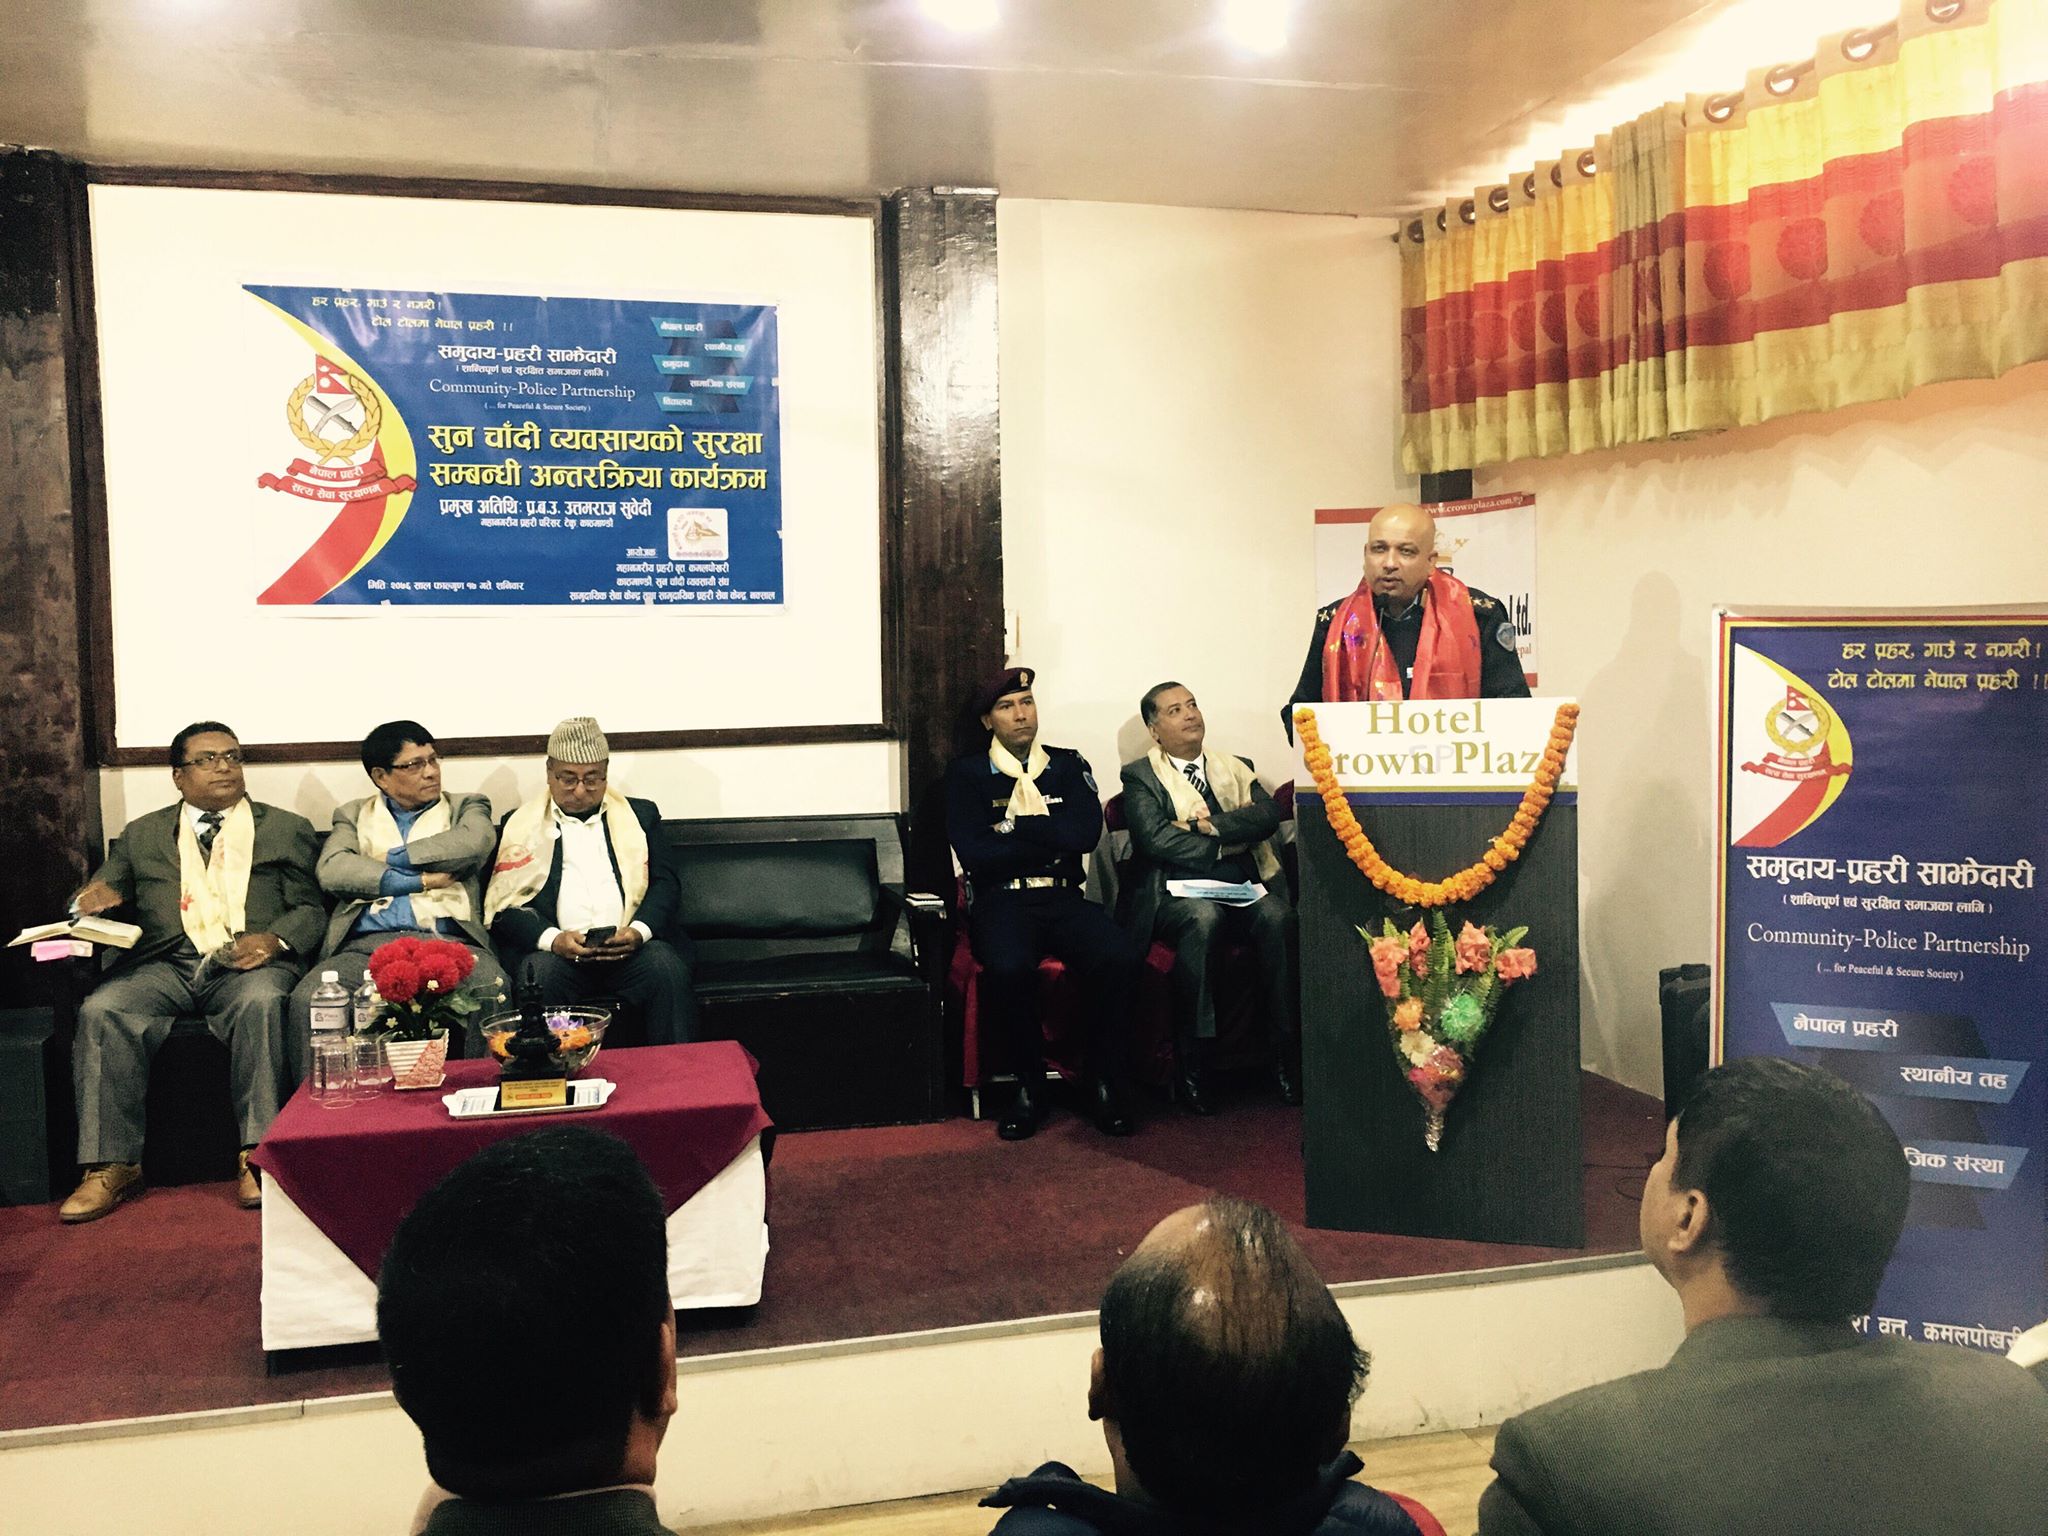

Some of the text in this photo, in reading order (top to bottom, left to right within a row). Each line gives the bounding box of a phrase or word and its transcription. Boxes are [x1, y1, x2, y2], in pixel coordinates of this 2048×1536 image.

[438, 344, 617, 365] समुदाय-प्रहरी साझेदारी
[429, 378, 636, 402] Community-Police Partnership
[427, 420, 763, 460] सुन चाँदी व्यवसायको सुरक्षा
[429, 458, 767, 491] सम्बन्धी अन्तरक्रिया कार्यक्रम
[439, 498, 473, 517] प्रमुख
[564, 500, 616, 516] उत्तमराज
[620, 497, 652, 519] सुवेदी
[1841, 642, 1866, 660] हर
[1964, 642, 1977, 659] र
[1827, 668, 1858, 689] टोल
[1866, 668, 1916, 689] टोलमा
[1923, 668, 1969, 689] नेपाल
[1976, 668, 2020, 692] प्रहरी
[1366, 700, 1486, 734] Hotel
[1322, 741, 1544, 776] rown Plaz
[1746, 854, 2036, 890] समुदाय-प्रहरी साझेदारी
[1843, 893, 1858, 908] एवं
[1861, 893, 1901, 912] सुरक्षित
[1904, 898, 1953, 913] समाजका
[1957, 899, 1985, 914] लागि
[1747, 922, 2031, 961] Community-Police Partnership
[1834, 962, 1847, 973] for
[1848, 963, 1884, 975] Peaceful
[1886, 965, 1894, 976] &
[1896, 966, 1925, 978] Secure
[1793, 1013, 1899, 1037] नेपाल प्रहरी
[1900, 1065, 2008, 1090] स्थानीय तह
[1952, 1154, 2005, 1174] संस्था
